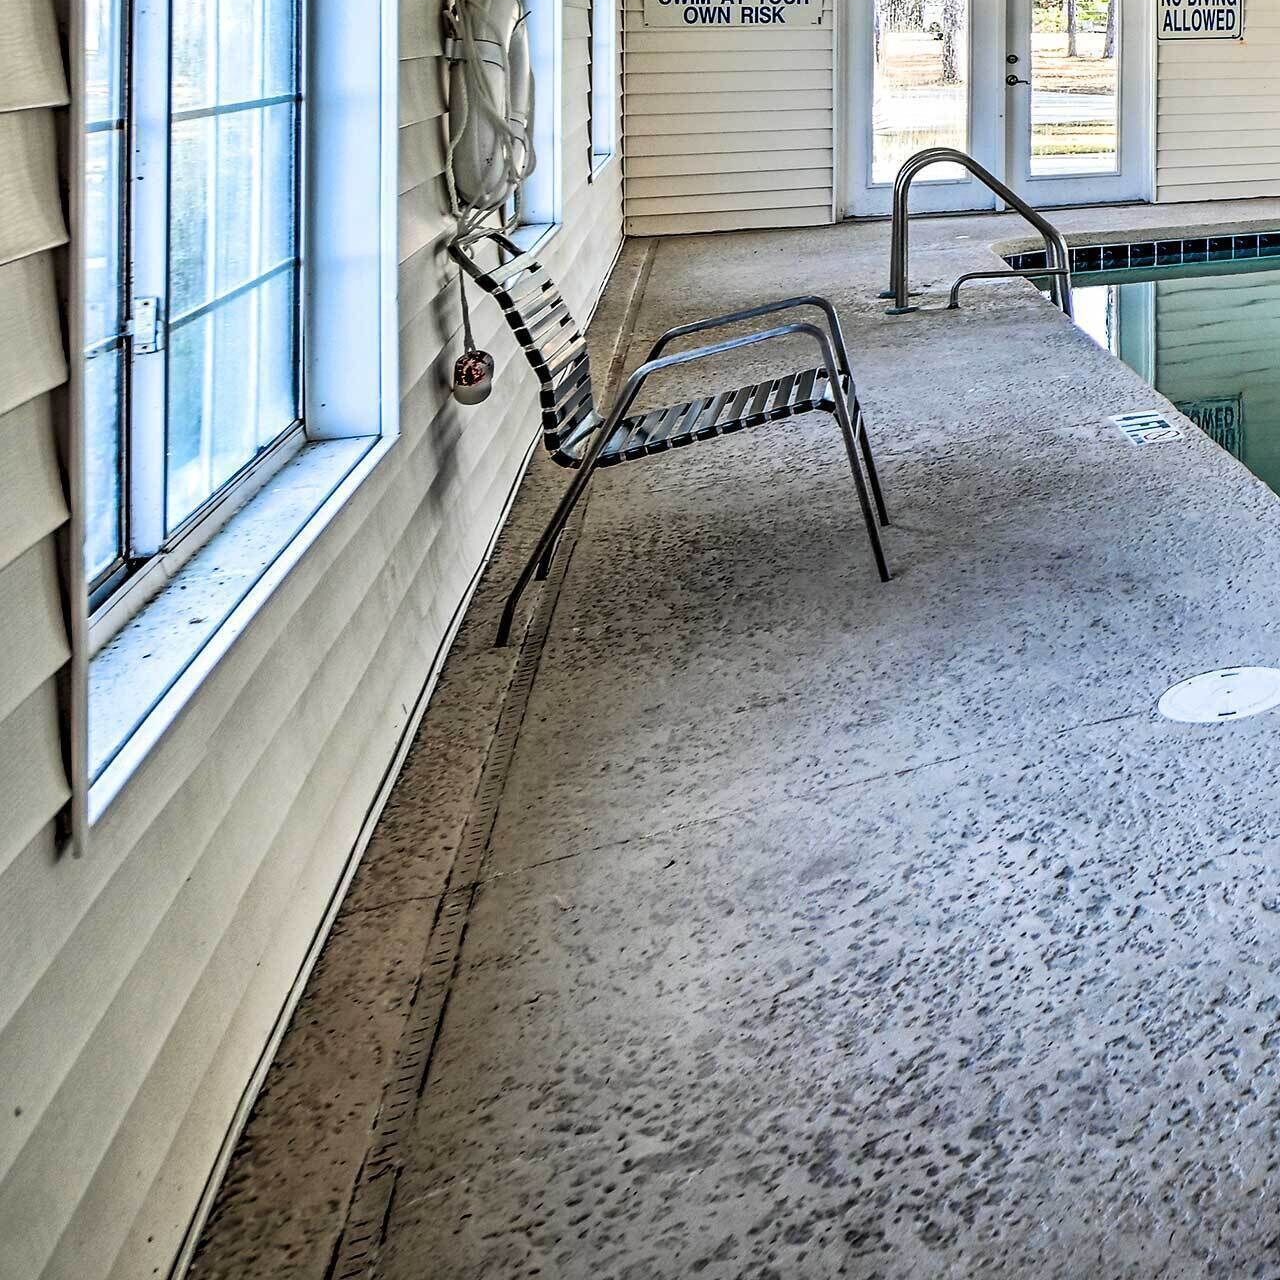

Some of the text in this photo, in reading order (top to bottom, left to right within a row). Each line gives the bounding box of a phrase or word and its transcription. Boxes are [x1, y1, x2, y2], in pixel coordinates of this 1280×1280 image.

[683, 6, 786, 24] OWN RISK
[1162, 8, 1236, 32] ALLOWED
